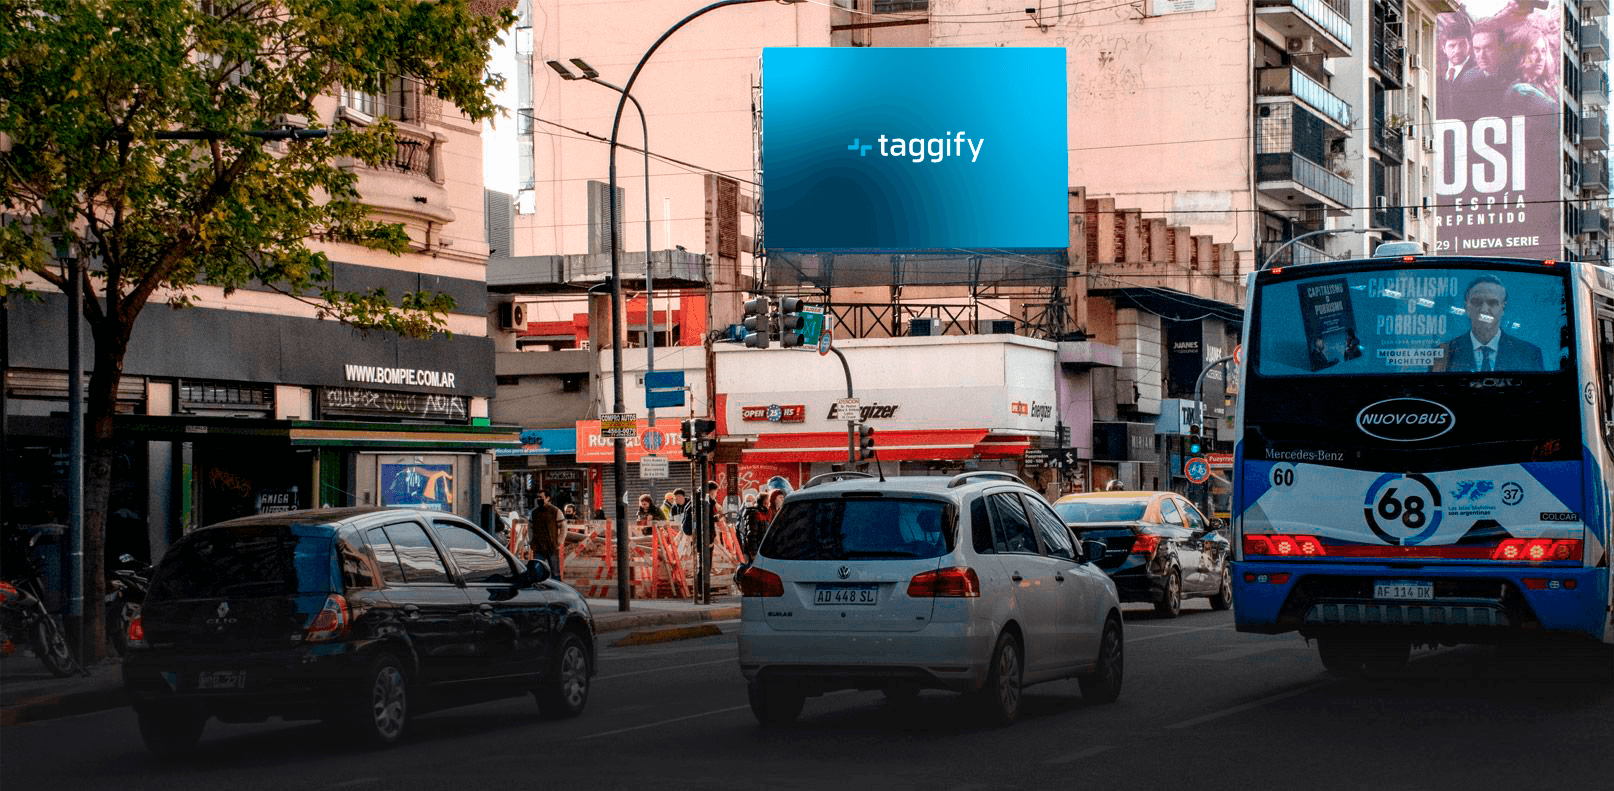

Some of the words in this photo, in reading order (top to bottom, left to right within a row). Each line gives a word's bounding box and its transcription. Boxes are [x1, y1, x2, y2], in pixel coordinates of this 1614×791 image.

[878, 131, 984, 163] taggify
[1455, 192, 1526, 212] ESPÍA
[1436, 212, 1526, 226] REPENTIDO
[1436, 240, 1450, 250] 29
[1463, 238, 1502, 249] NUEVA
[1506, 236, 1539, 247] SERIE
[1368, 277, 1459, 298] CAPITALISMO
[1408, 299, 1416, 313] O
[1376, 315, 1447, 335] POBRISMO
[345, 364, 456, 388] WWW.BOMPIE.COM.AR
[827, 402, 899, 422] Egizer
[1361, 413, 1448, 425] NUOVOBUS
[1265, 448, 1344, 461] Mercedes-Benz
[1273, 468, 1294, 486] 60
[261, 493, 289, 504] AMIGA
[1503, 489, 1519, 500] 37
[1378, 487, 1426, 529] 68
[1542, 513, 1577, 521] COLCAR
[817, 590, 832, 602] AD
[835, 590, 856, 602] 448
[860, 590, 874, 602] SL
[1378, 586, 1390, 597] AF
[1394, 586, 1414, 598] 114
[1417, 587, 1431, 598] DK
